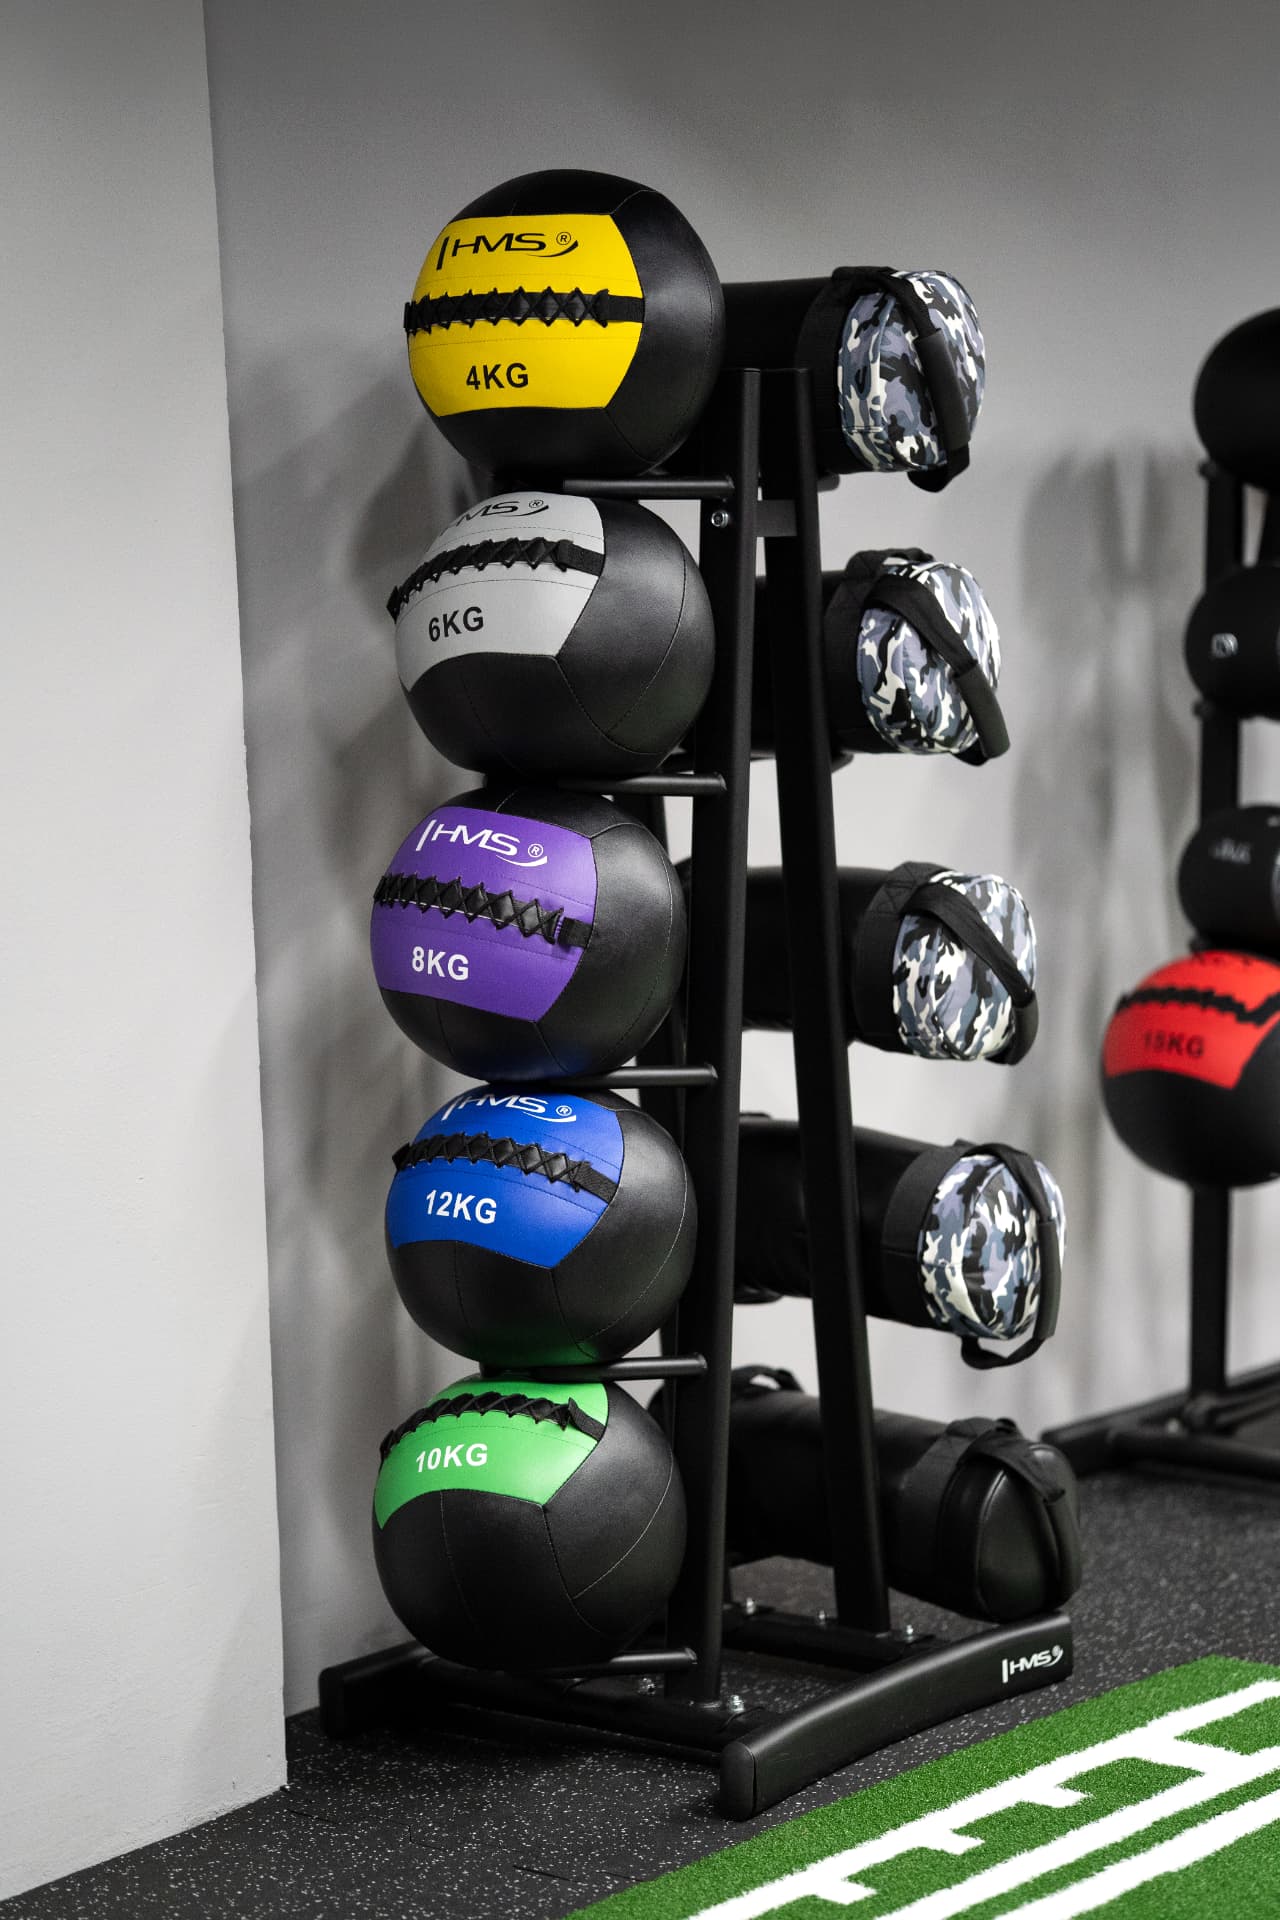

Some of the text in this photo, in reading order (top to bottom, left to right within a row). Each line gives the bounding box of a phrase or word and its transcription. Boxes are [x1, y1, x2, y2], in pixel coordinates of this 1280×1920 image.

[451, 232, 547, 257] HMS
[465, 362, 529, 391] 4KG
[428, 606, 485, 642] 6KG
[431, 824, 521, 857] HMS
[411, 945, 470, 981] 8KG
[425, 1189, 498, 1225] 12KG
[414, 1442, 489, 1474] 10KG
[1009, 1649, 1053, 1676] HMS
